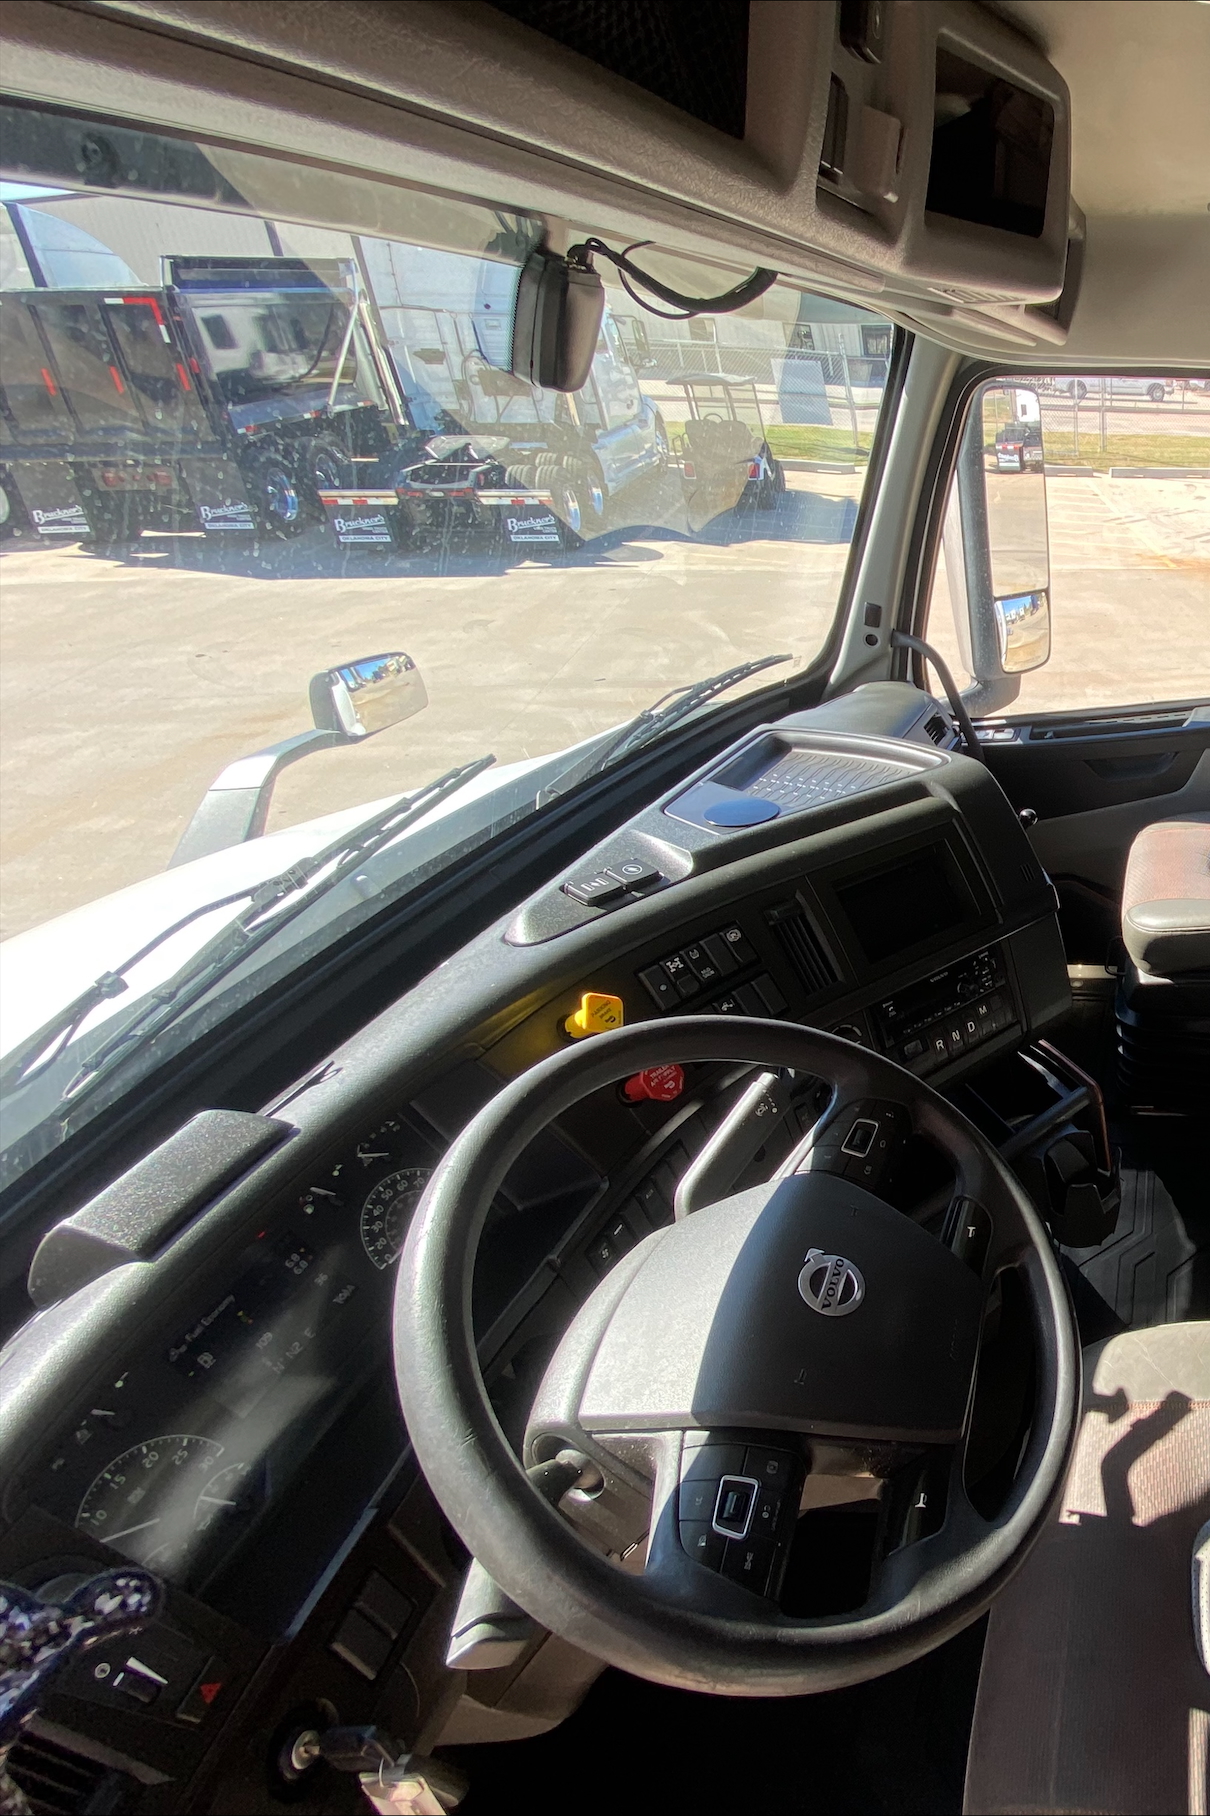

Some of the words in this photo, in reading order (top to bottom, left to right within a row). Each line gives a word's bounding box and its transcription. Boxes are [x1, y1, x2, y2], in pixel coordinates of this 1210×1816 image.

[935, 1039, 944, 1051] R
[952, 1030, 960, 1042] N
[967, 1021, 976, 1033] D
[820, 1258, 845, 1311] VOLVO
[142, 1451, 160, 1470] 20
[172, 1448, 188, 1466] 25
[110, 1474, 126, 1490] 15
[90, 1509, 108, 1526] 10
